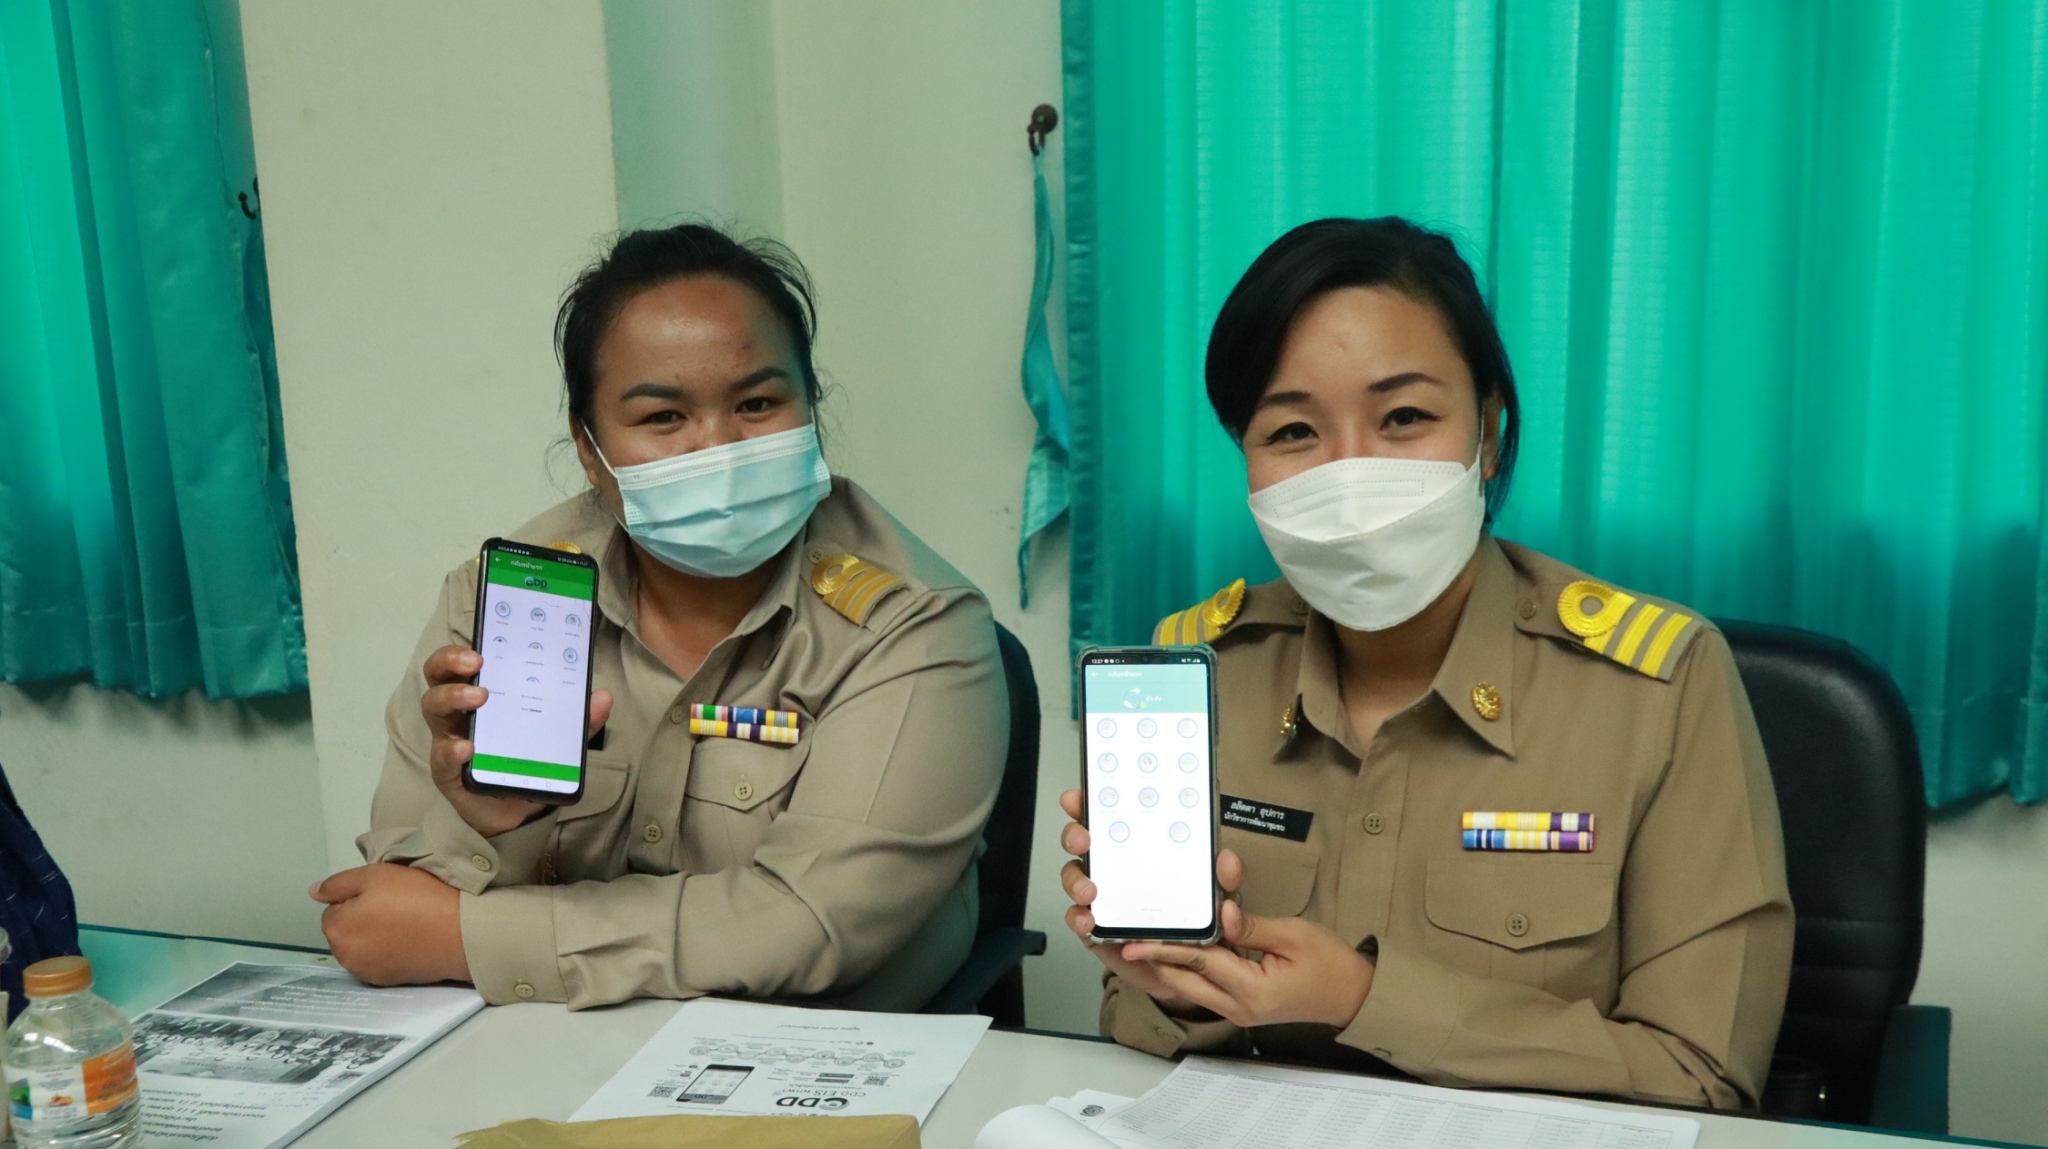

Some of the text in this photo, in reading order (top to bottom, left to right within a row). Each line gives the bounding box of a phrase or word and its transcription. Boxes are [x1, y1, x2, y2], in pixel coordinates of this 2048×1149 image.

[813, 1089, 837, 1098] EIS
[841, 1090, 866, 1098] CDD
[776, 1096, 850, 1111] CDD
